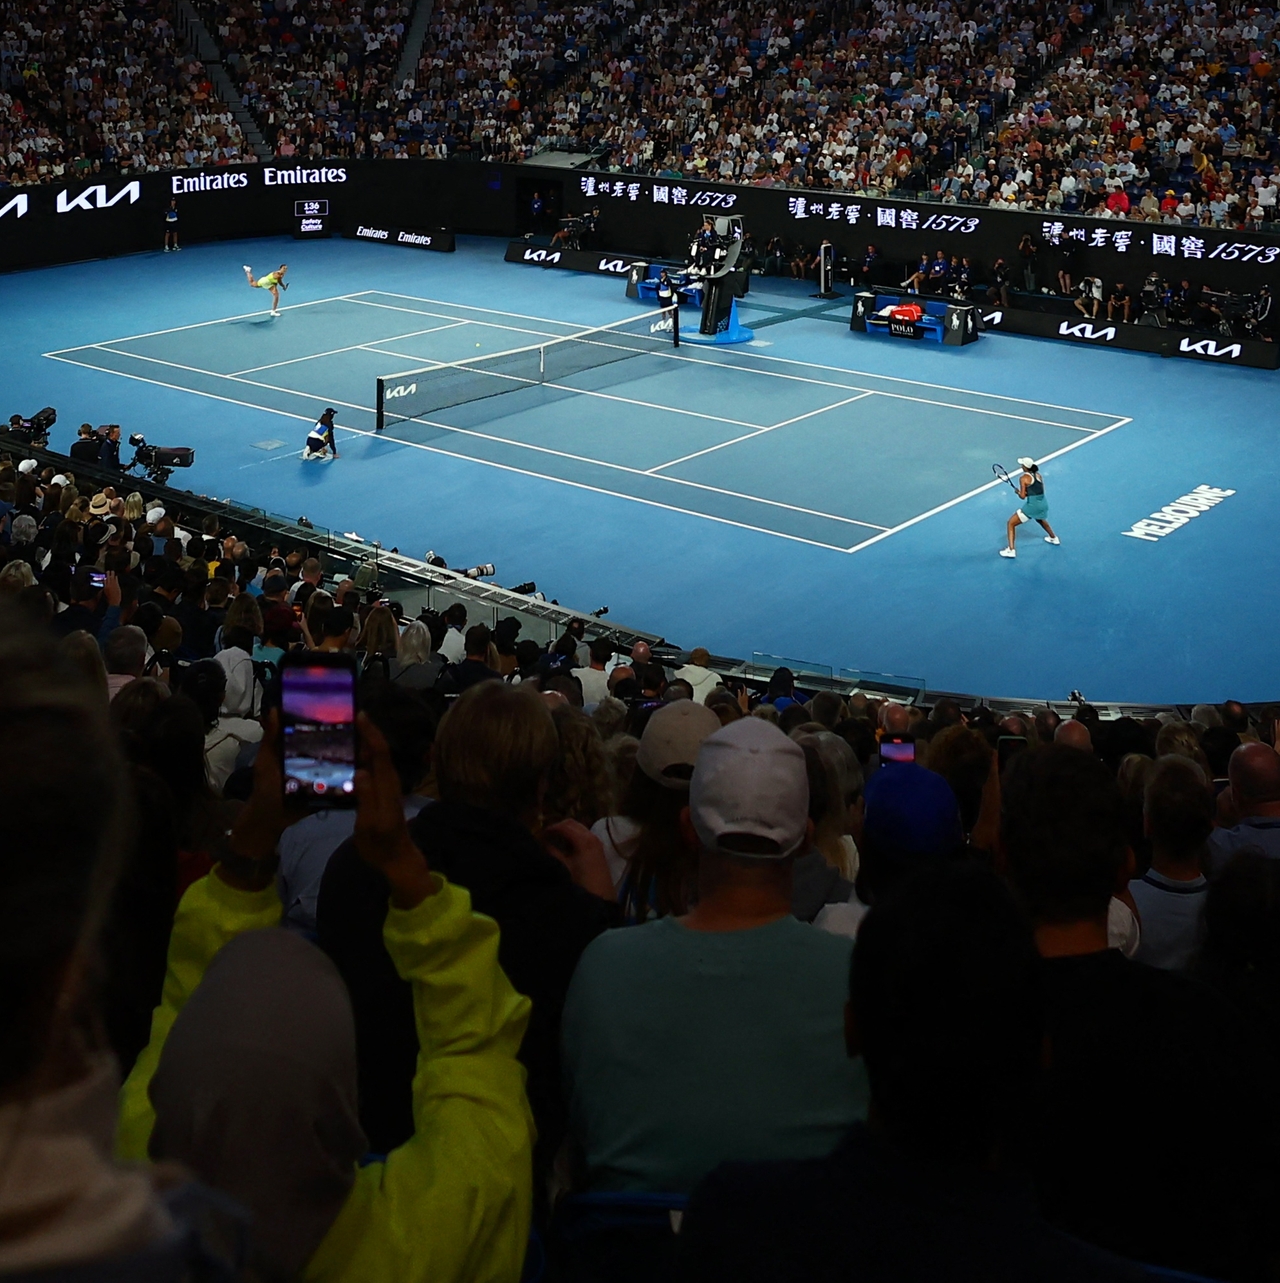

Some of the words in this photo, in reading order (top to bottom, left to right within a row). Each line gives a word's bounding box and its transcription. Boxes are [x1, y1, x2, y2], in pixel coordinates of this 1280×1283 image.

[171, 171, 248, 194] Emirates
[263, 165, 347, 186] Emirates
[56, 180, 140, 213] KIA
[304, 202, 320, 210] 136
[356, 225, 389, 240] Emirates
[397, 231, 432, 246] Emirates
[523, 247, 562, 264] KIA
[598, 258, 632, 274] KI
[891, 323, 914, 333] POLO
[1058, 320, 1117, 342] KIA
[1179, 337, 1242, 359] KIA
[385, 383, 417, 399] KIA
[1120, 484, 1237, 542] MELBOURNE
